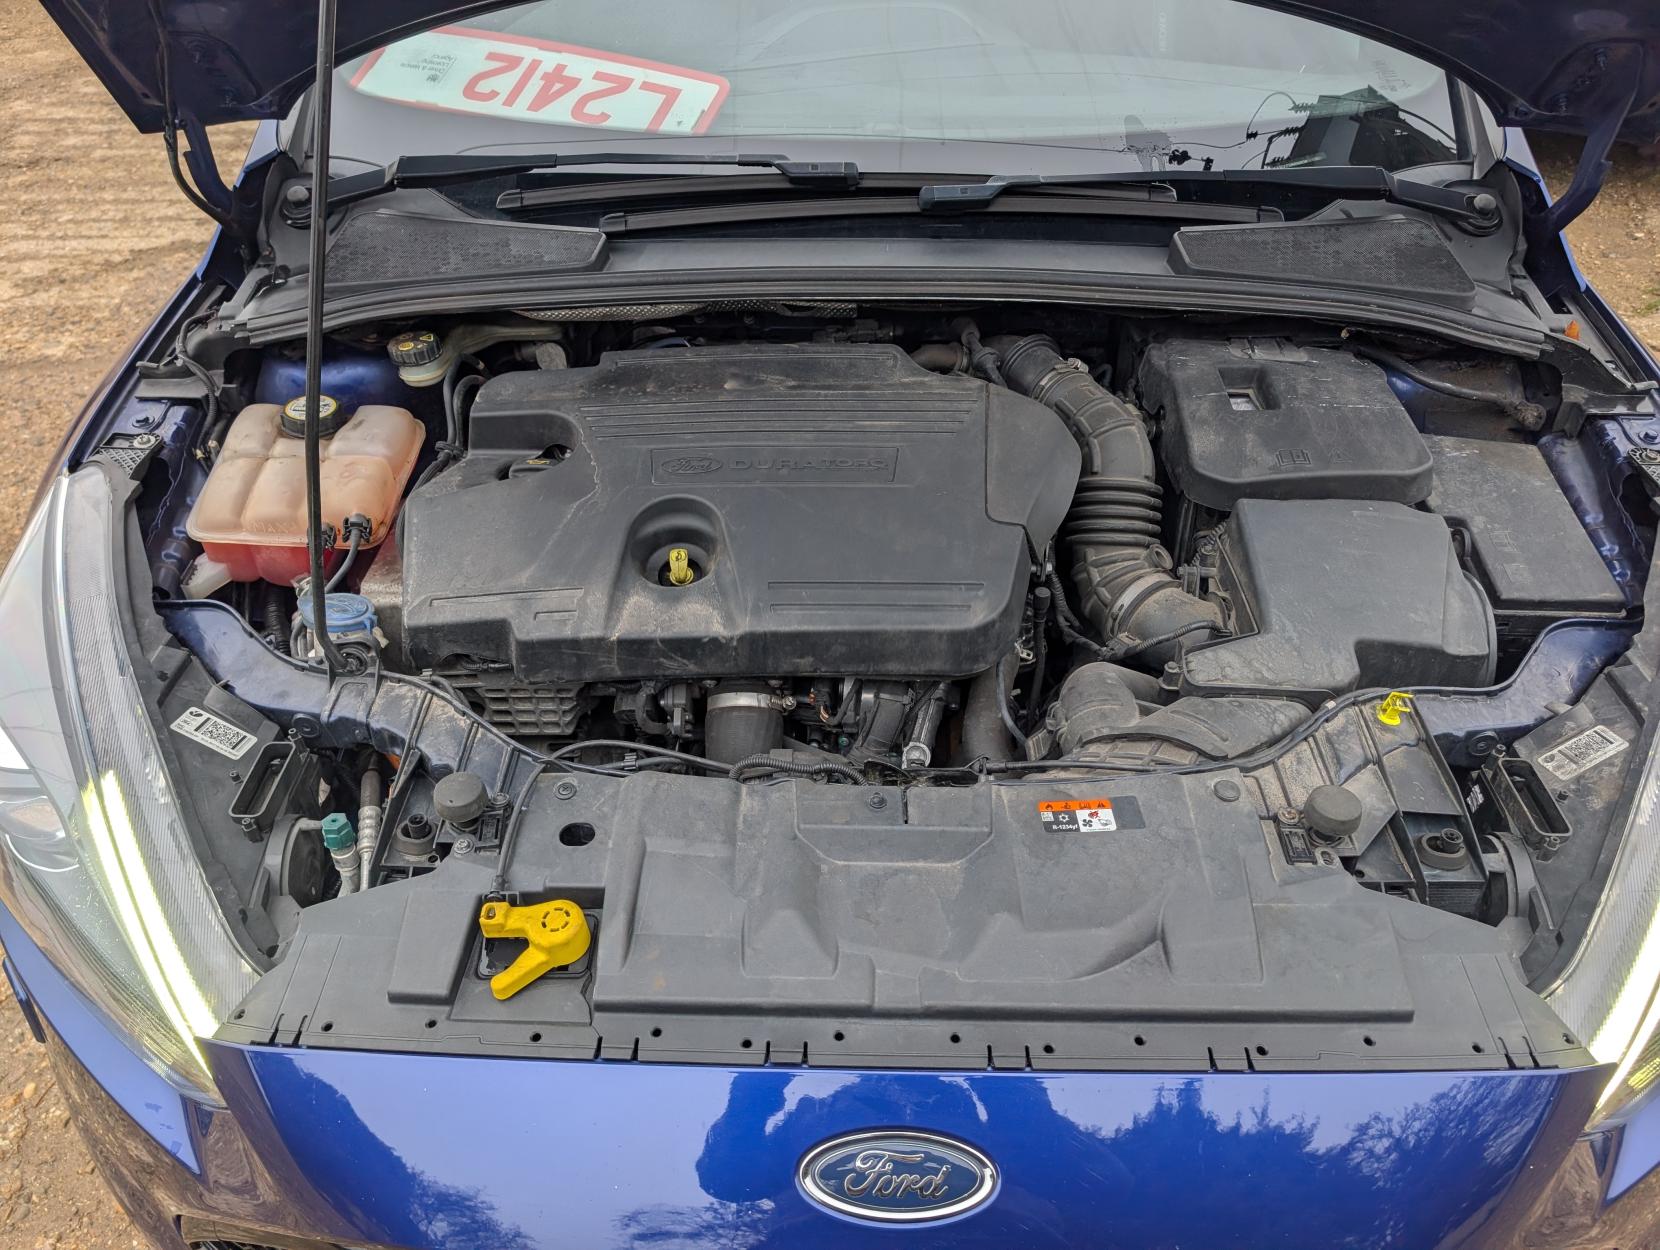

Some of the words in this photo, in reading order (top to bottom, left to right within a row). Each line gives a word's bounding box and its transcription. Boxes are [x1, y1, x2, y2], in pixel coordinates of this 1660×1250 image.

[462, 51, 682, 134] L2412
[671, 457, 711, 472] Ford
[844, 1150, 951, 1198] Ford
